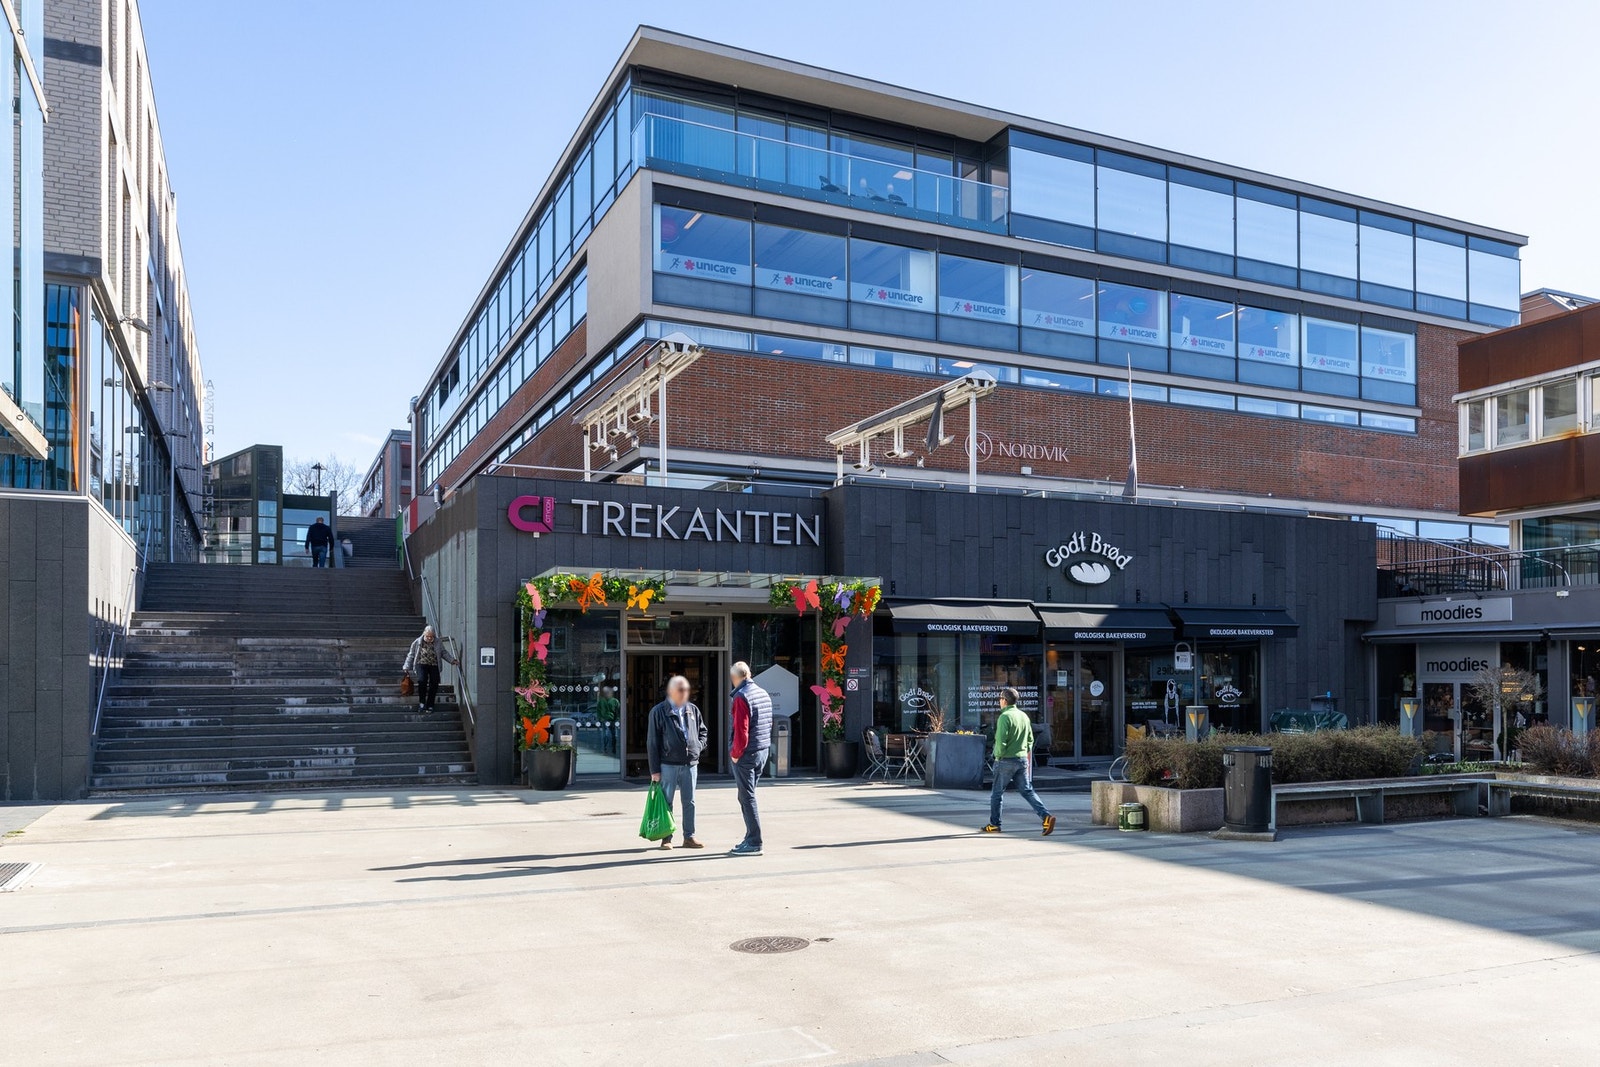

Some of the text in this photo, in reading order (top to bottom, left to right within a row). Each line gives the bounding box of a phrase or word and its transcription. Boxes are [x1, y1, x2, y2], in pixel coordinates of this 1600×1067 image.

[696, 260, 737, 275] unicare
[794, 276, 833, 290] unicare
[888, 291, 924, 304] unicare
[973, 304, 1006, 316] unicare
[1053, 316, 1084, 328] unicare
[1128, 328, 1157, 339] unicare
[1198, 338, 1226, 350] unicare
[1264, 349, 1291, 360] unicare
[1326, 359, 1350, 369] unicare
[1384, 368, 1408, 377] unicare
[999, 441, 1070, 462] NORDVIK
[571, 498, 820, 547] TREKANTEN
[1045, 531, 1133, 570] Godt Brød
[1420, 604, 1483, 621] moodies
[927, 623, 1008, 633] ØKOLOGISK BAKEVERKSTED
[1209, 628, 1275, 637] ØKOLOGISK BAKEVERKSTED
[1074, 631, 1147, 640] ØKOLOGISK BAKEVERKSTED
[1426, 656, 1489, 672] moodies
[899, 687, 935, 702] Godt Brød
[968, 691, 1000, 699] ØKOLOGISK
